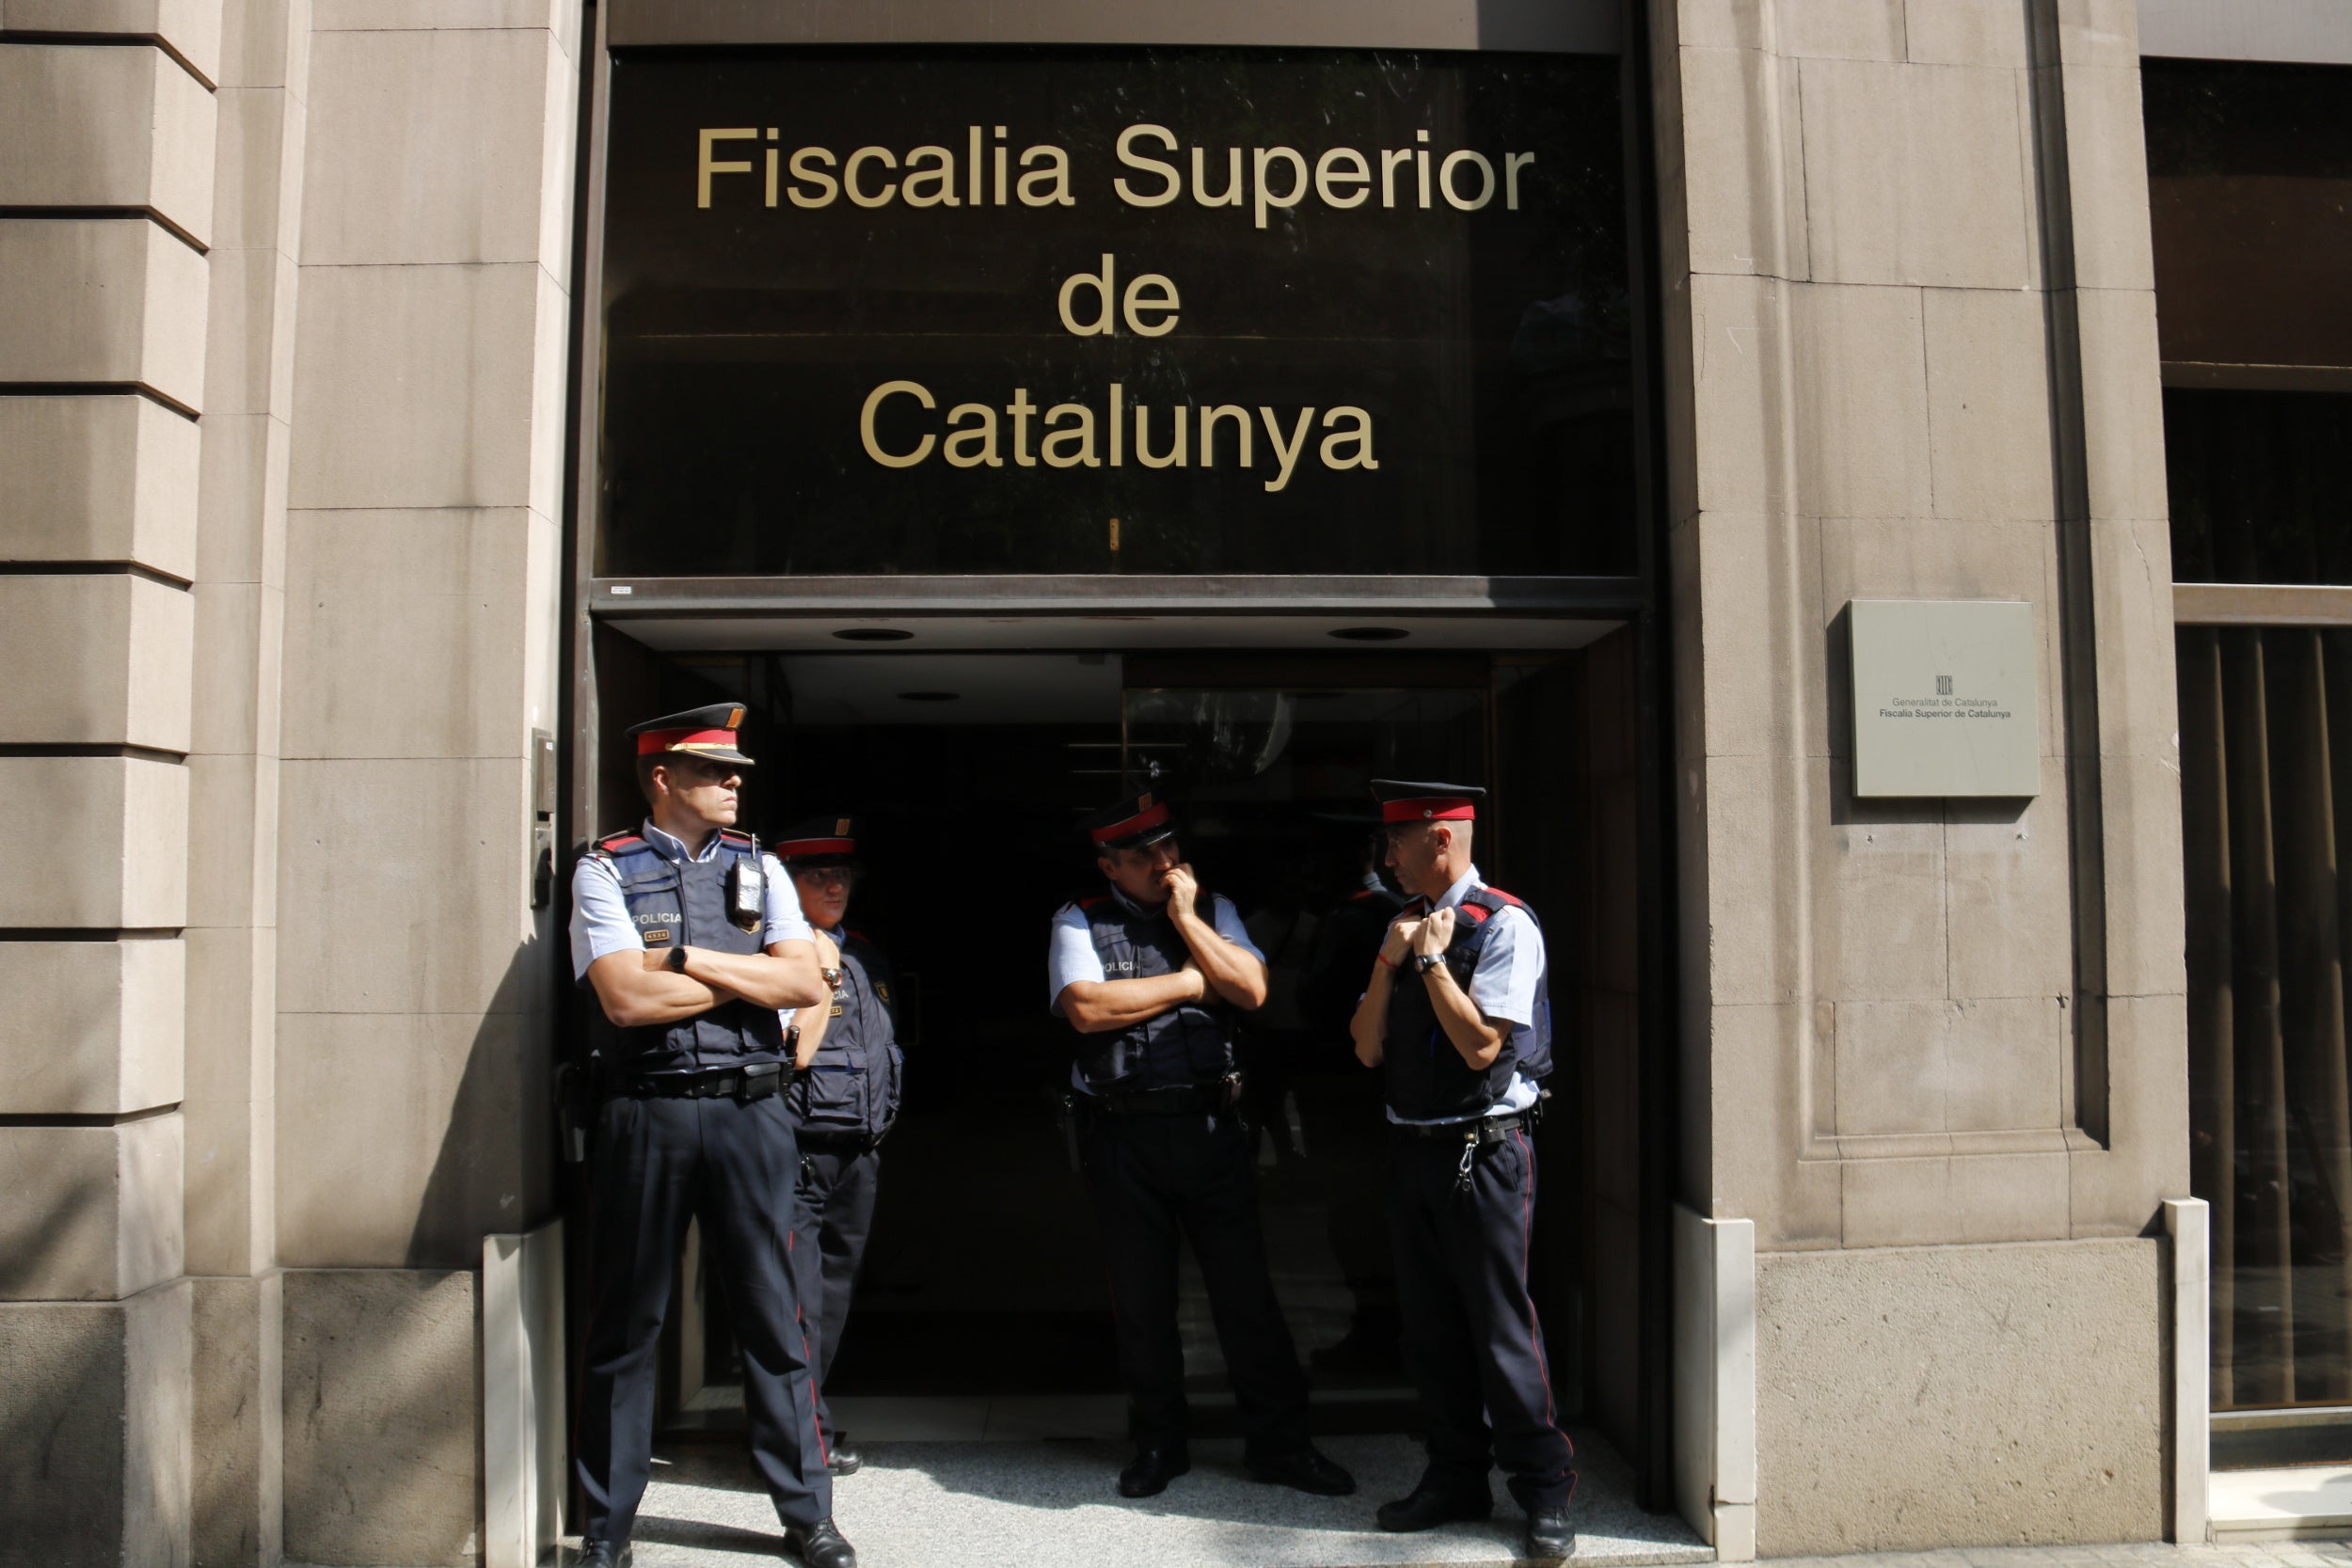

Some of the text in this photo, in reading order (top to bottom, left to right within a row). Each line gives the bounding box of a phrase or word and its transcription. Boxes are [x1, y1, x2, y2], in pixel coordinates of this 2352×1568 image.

[697, 123, 1536, 229] Fiscalia Superior
[1057, 252, 1182, 338] de
[860, 379, 1379, 493] Catalunya
[1880, 708, 2010, 720] Fiscalia Superior de Catalunya
[1892, 697, 1997, 708] Generalitat de Catalunya
[631, 912, 683, 925] POLICIA
